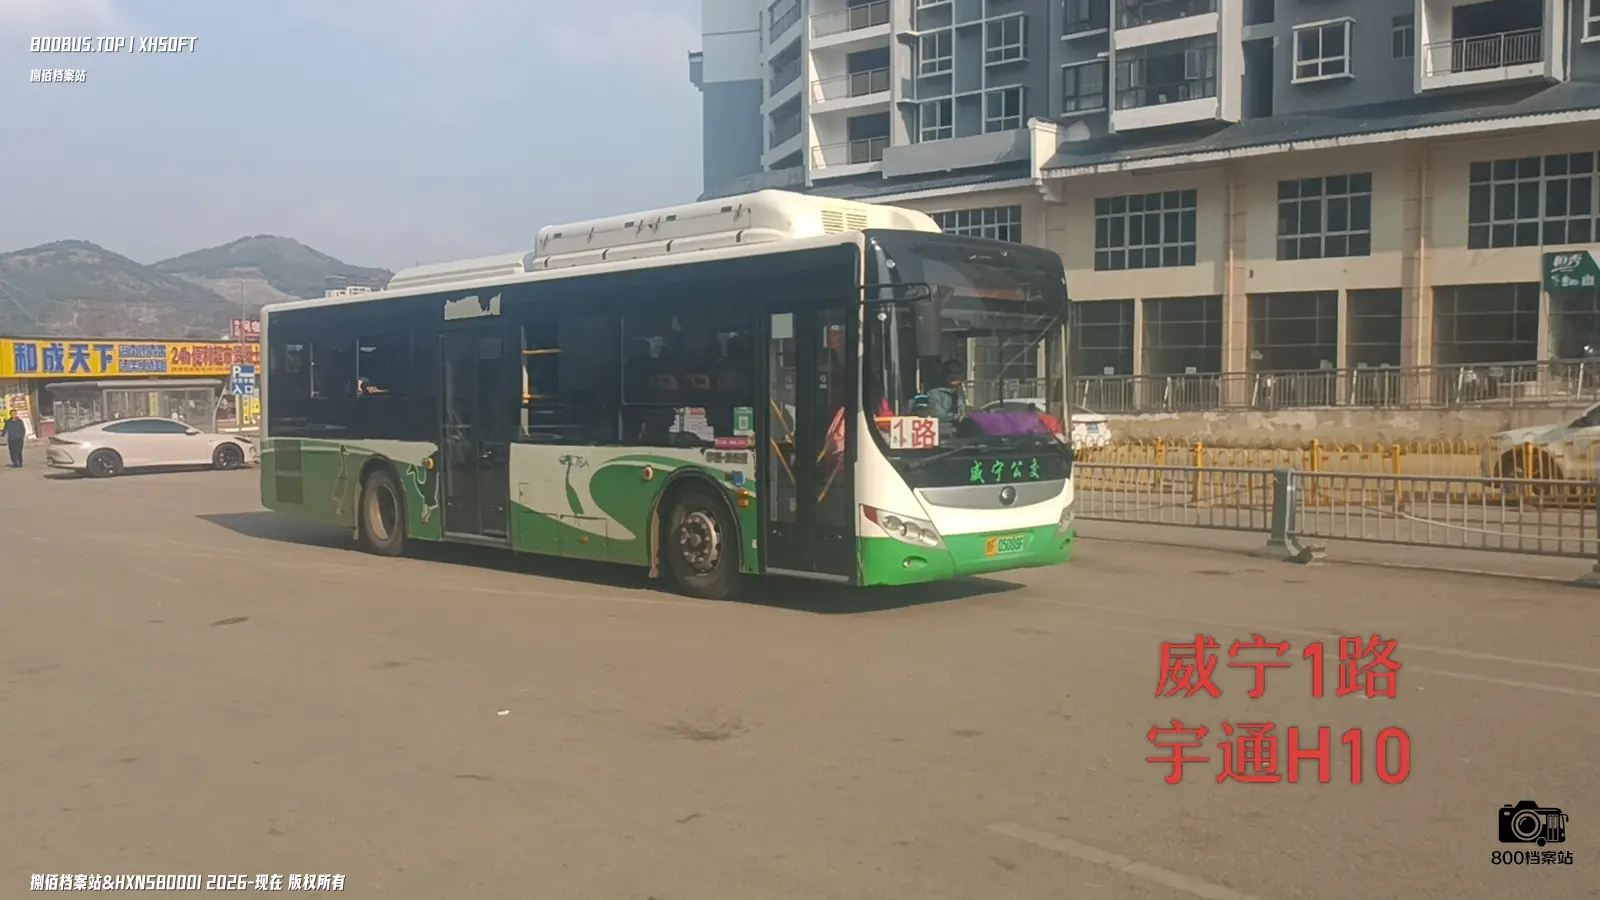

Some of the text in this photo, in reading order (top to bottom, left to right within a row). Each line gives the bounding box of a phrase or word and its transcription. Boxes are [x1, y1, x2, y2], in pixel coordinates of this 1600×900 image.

[14, 343, 114, 373] 和成天下
[232, 366, 241, 377] P
[232, 384, 254, 395] 入口
[893, 418, 937, 448] 1路
[969, 457, 1041, 483] 威宁公交
